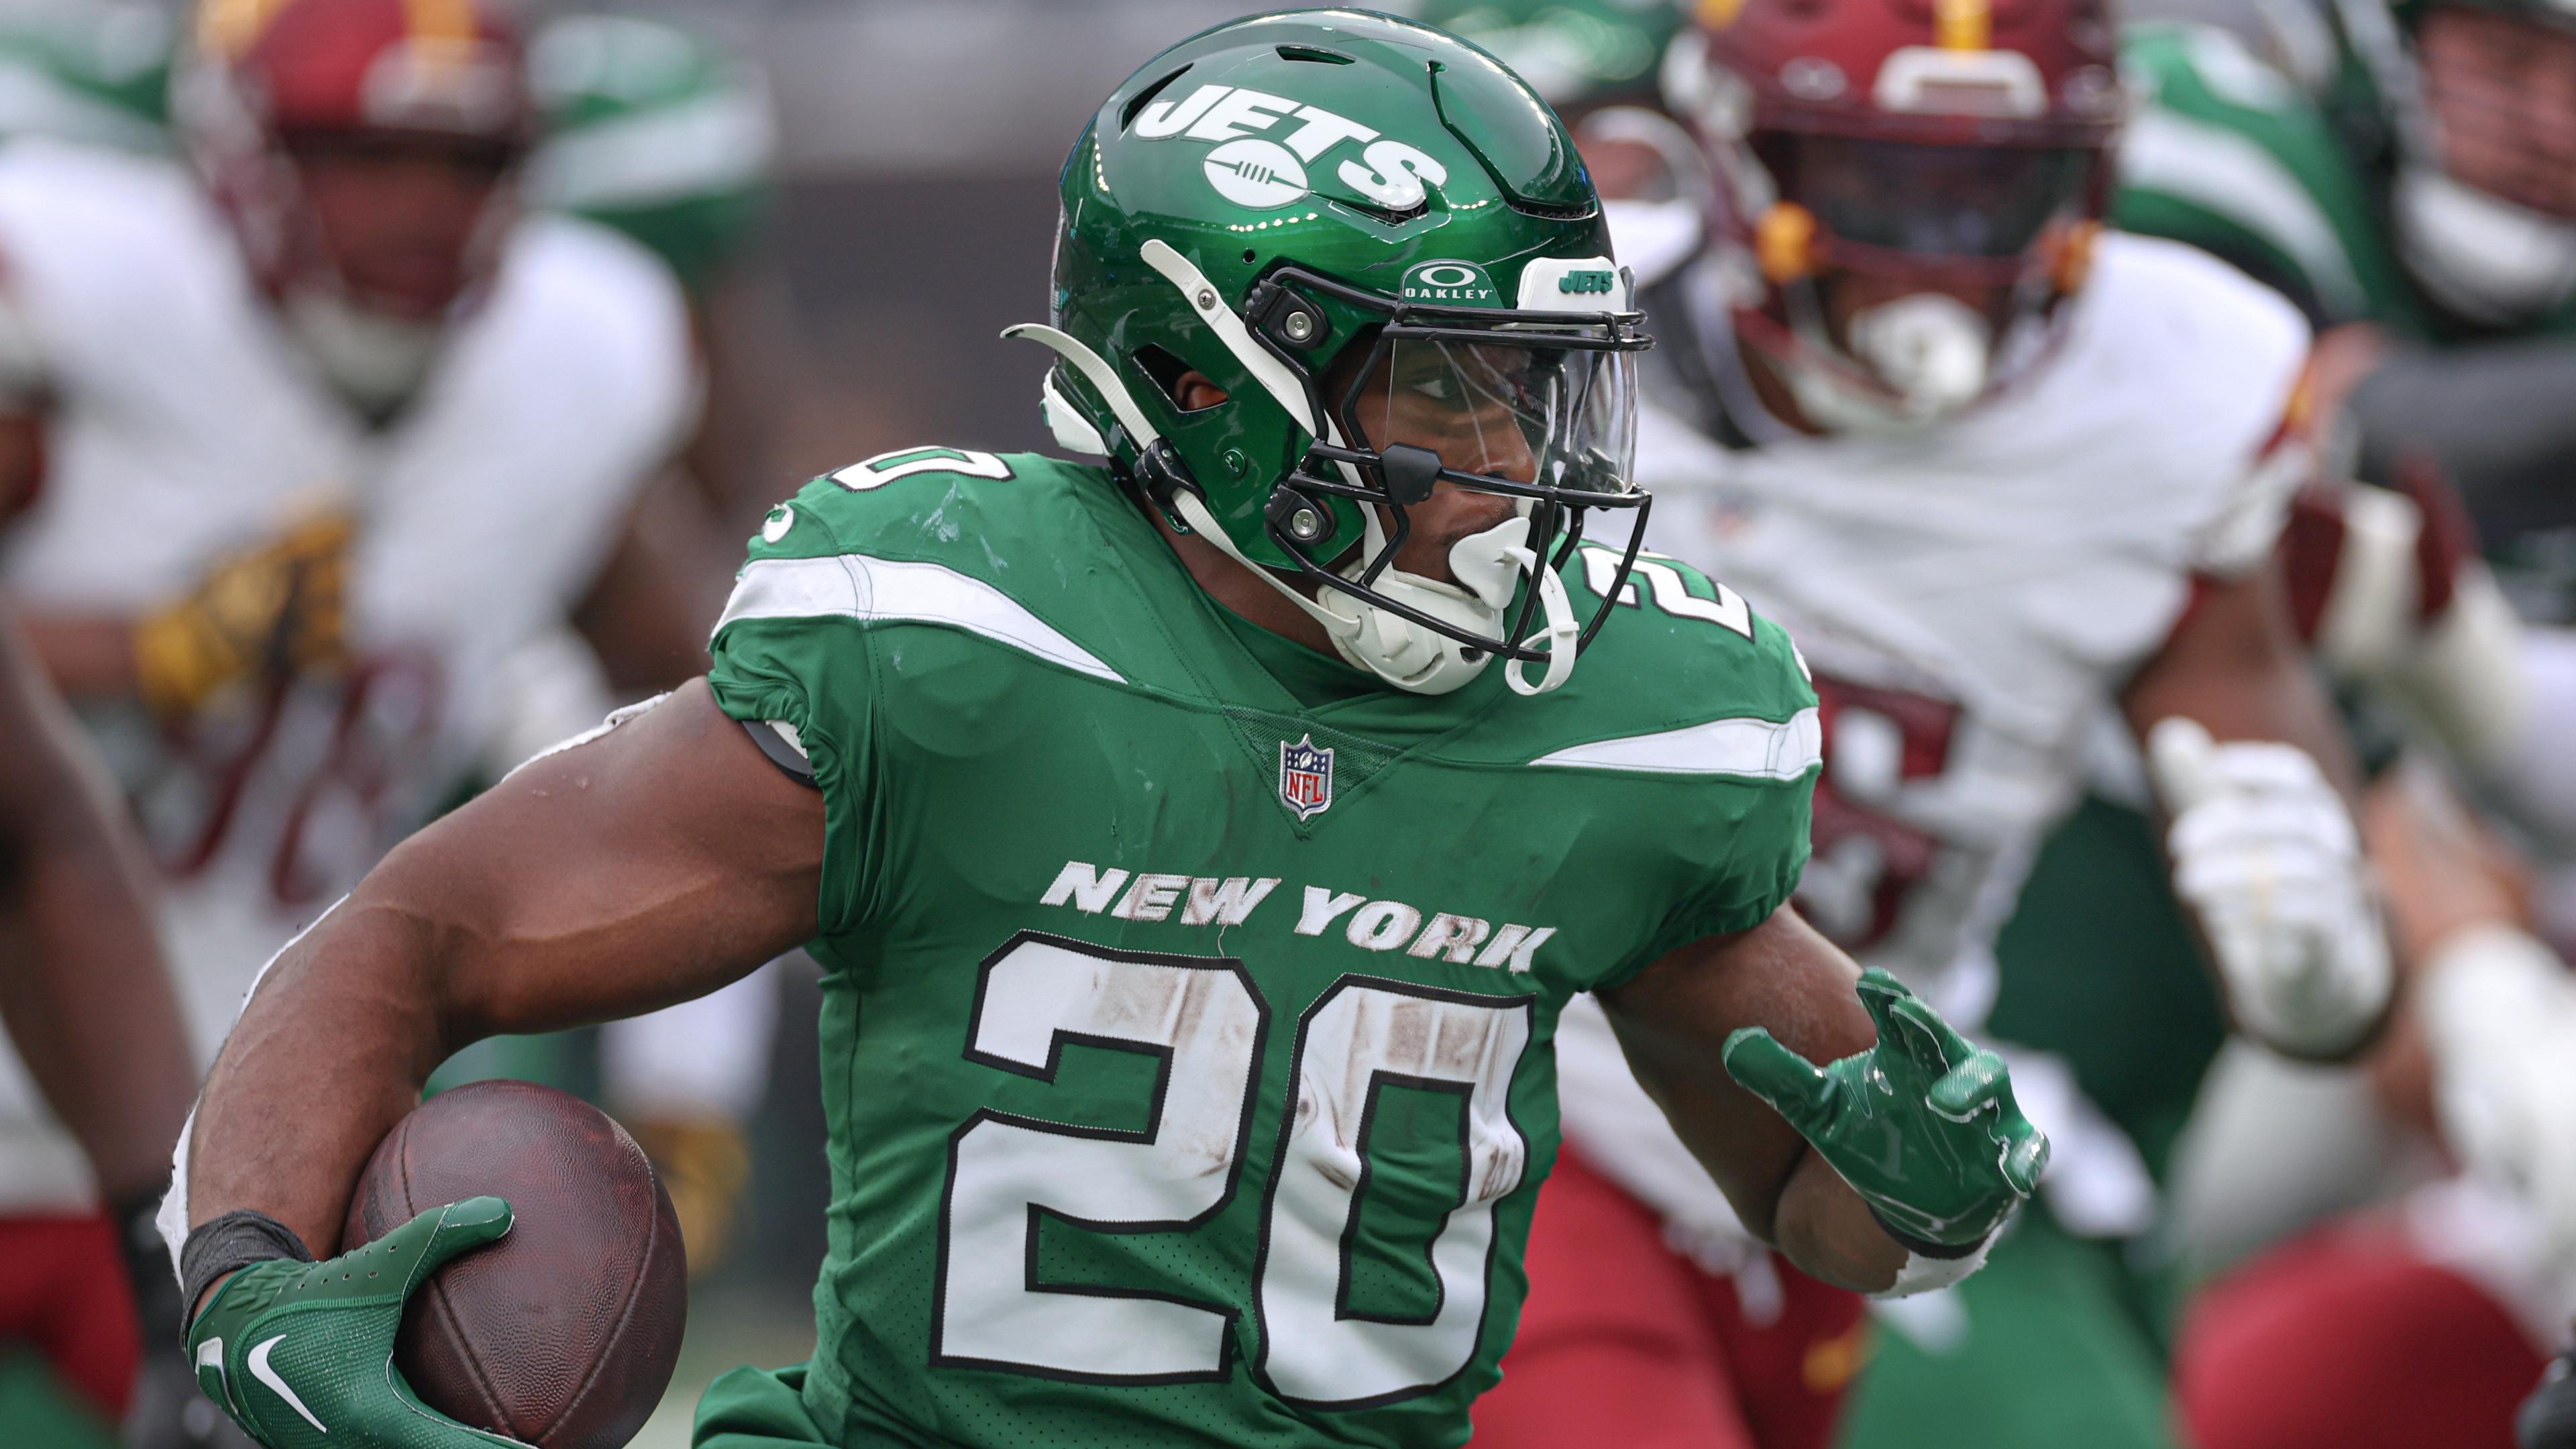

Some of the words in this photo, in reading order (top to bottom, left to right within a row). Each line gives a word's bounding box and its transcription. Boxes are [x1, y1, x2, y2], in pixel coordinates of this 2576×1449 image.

[1134, 84, 1448, 208] JETS
[1405, 288, 1489, 299] OAKLEY
[1558, 270, 1613, 294] JETS
[1287, 771, 1324, 805] NFL
[1039, 855, 1282, 926] NEW
[1293, 885, 1558, 974] YORK
[928, 929, 1536, 1412] 20
